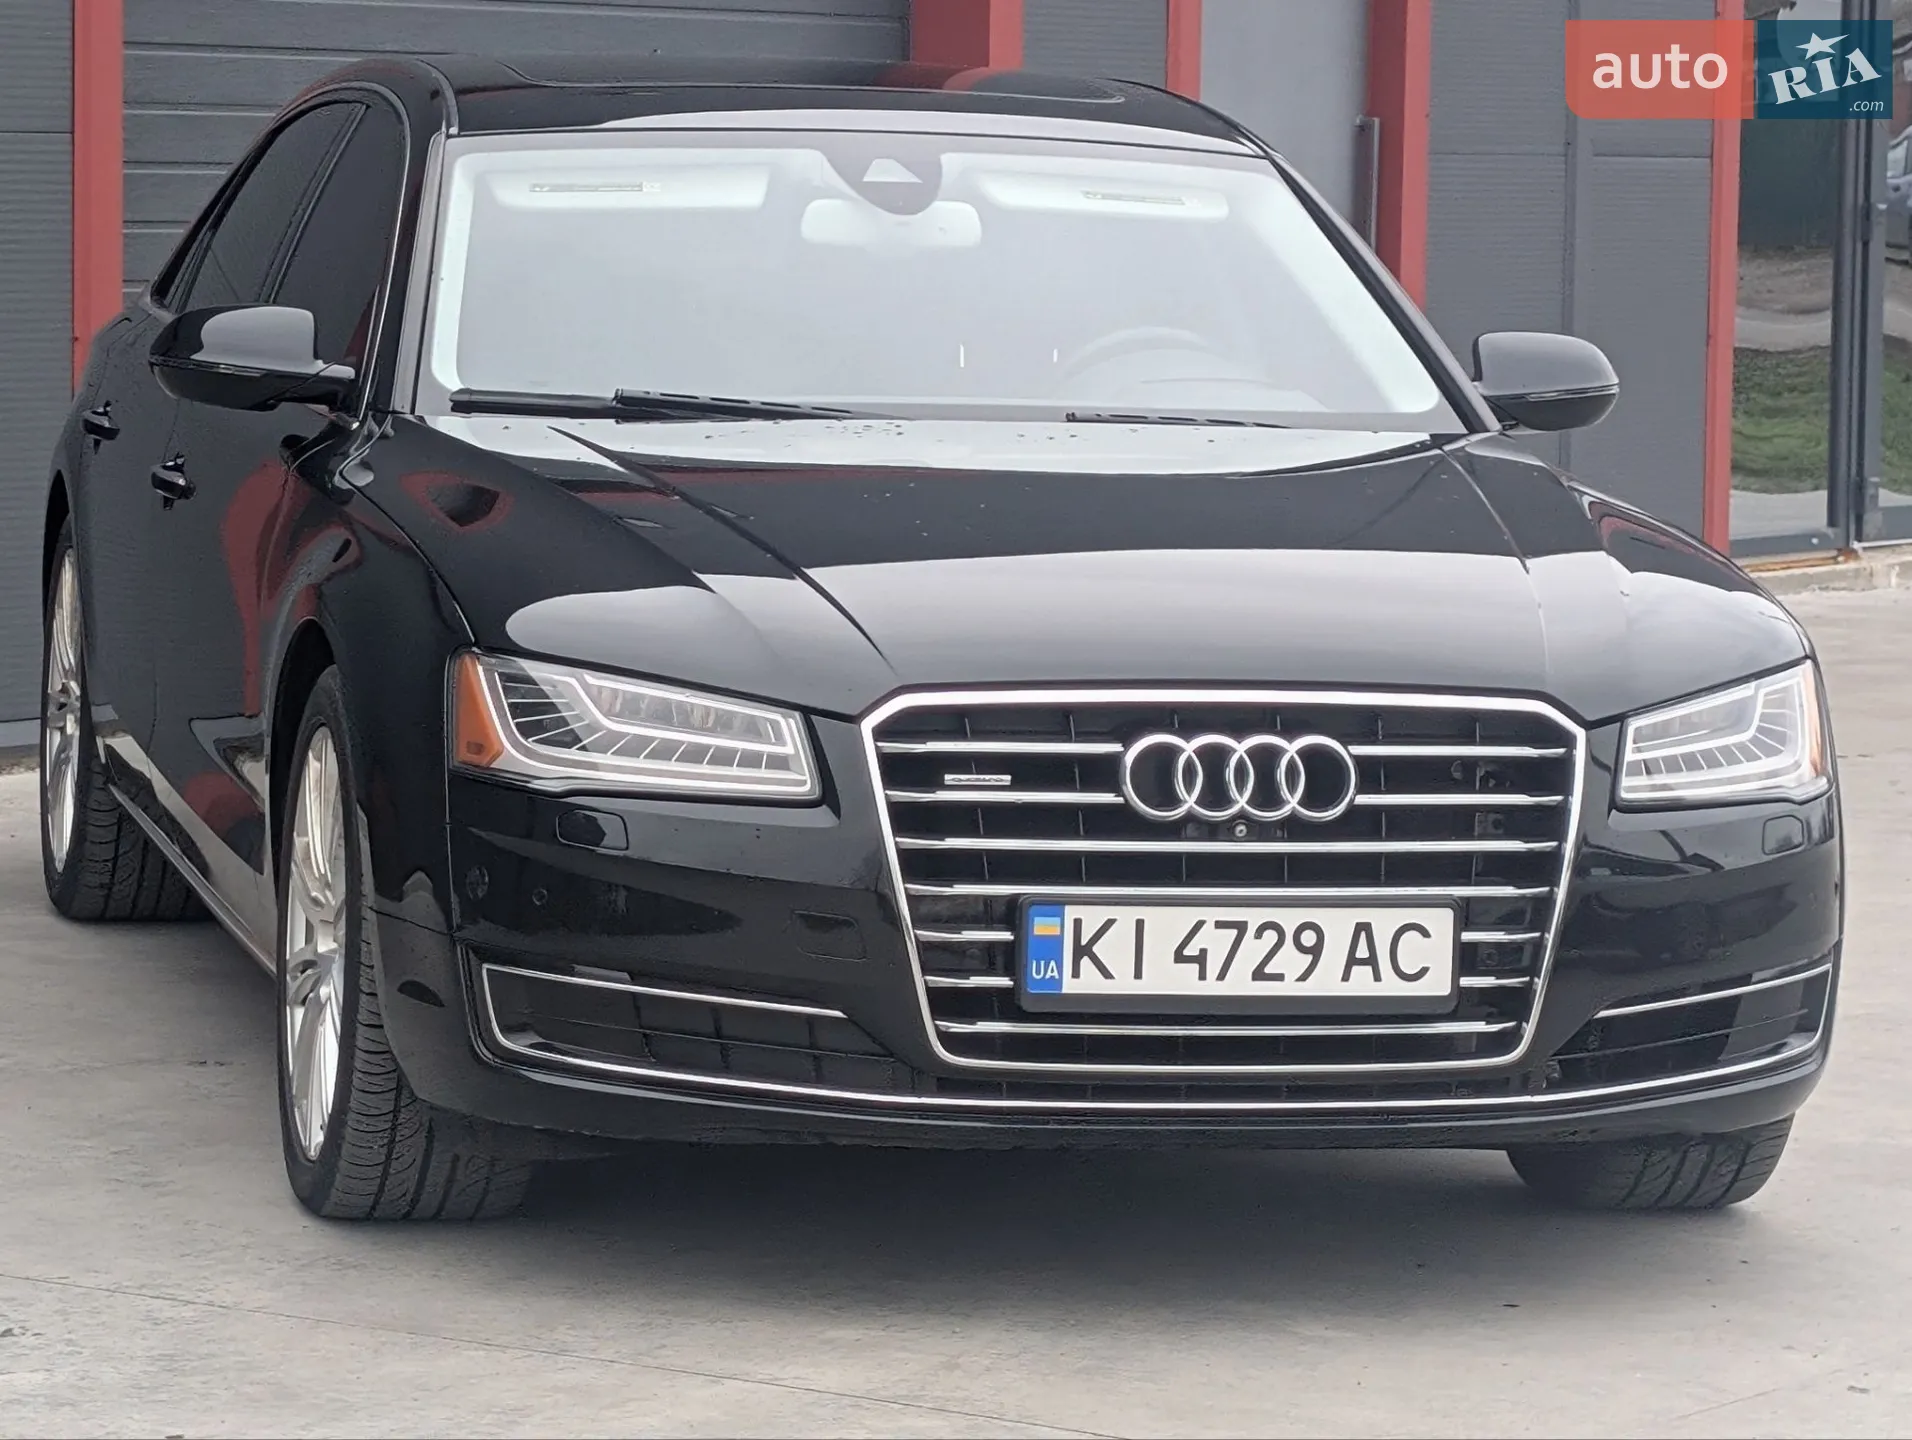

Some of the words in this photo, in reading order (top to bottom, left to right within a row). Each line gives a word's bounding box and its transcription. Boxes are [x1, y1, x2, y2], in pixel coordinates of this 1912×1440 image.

[1032, 960, 1060, 980] UA
[1070, 917, 1146, 980] KI
[1173, 919, 1325, 982] 4729
[1340, 921, 1431, 983] AC
